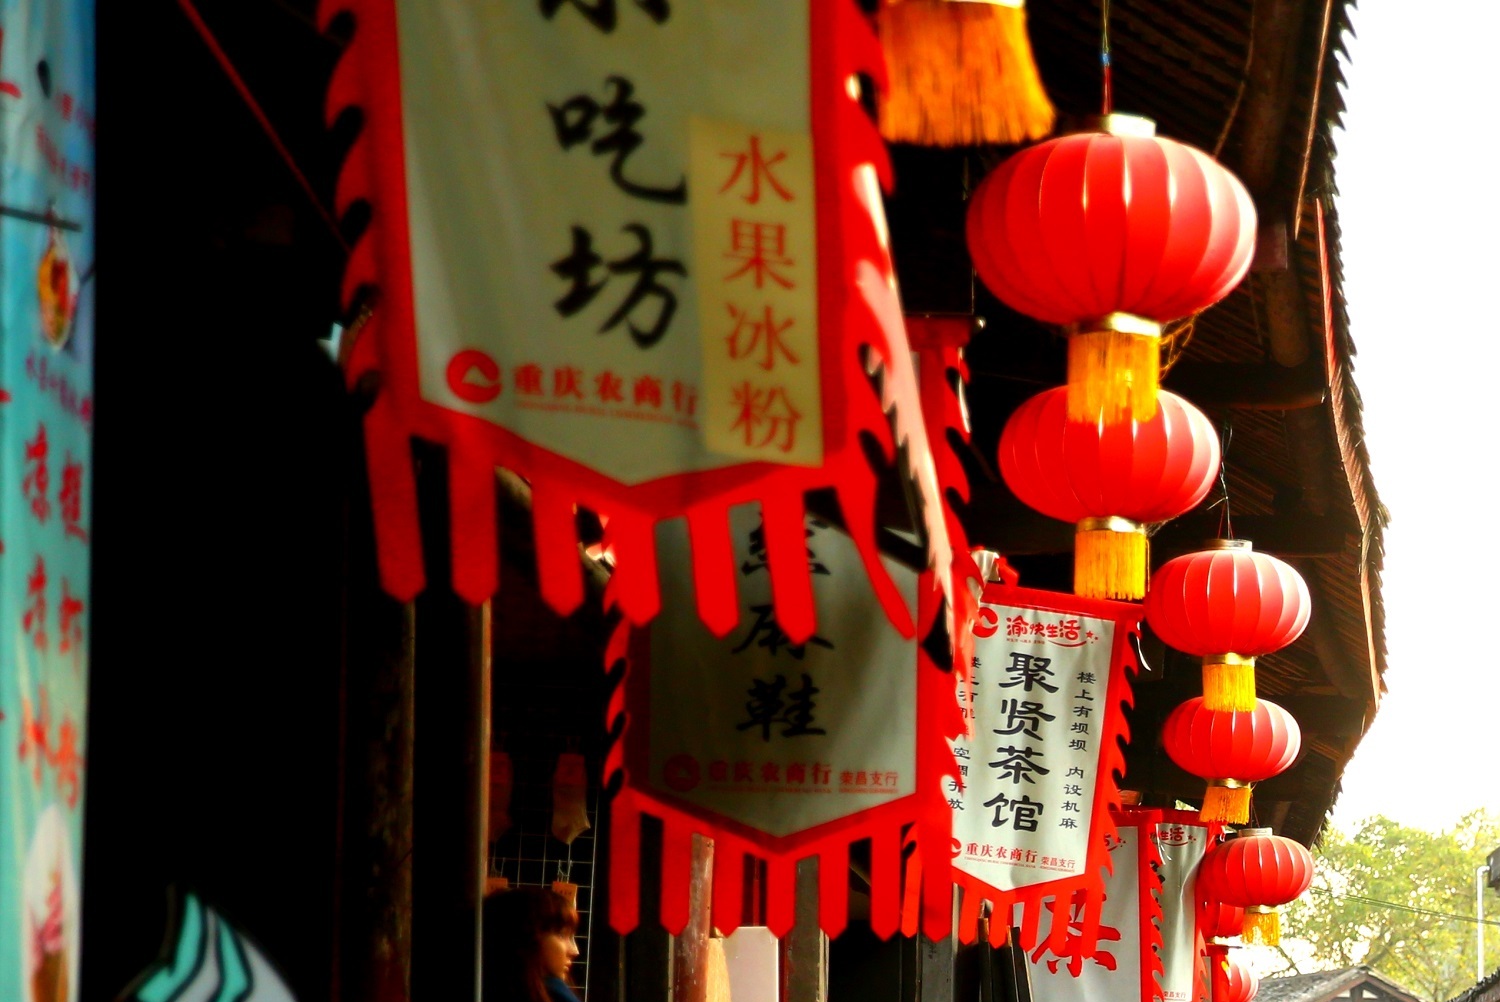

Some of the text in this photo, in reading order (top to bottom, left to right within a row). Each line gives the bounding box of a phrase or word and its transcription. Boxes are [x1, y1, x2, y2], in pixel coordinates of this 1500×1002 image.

[717, 134, 802, 454] 水果冰粉
[1006, 614, 1081, 641] 渝快生活
[840, 770, 899, 787] 荣昌支行
[983, 651, 1060, 833] 聚贤茶馆
[1058, 670, 1097, 830] 楼上有坝坝 内设机麻
[966, 842, 1038, 863] 重庆农商行
[1040, 856, 1076, 869] 荣昌支行
